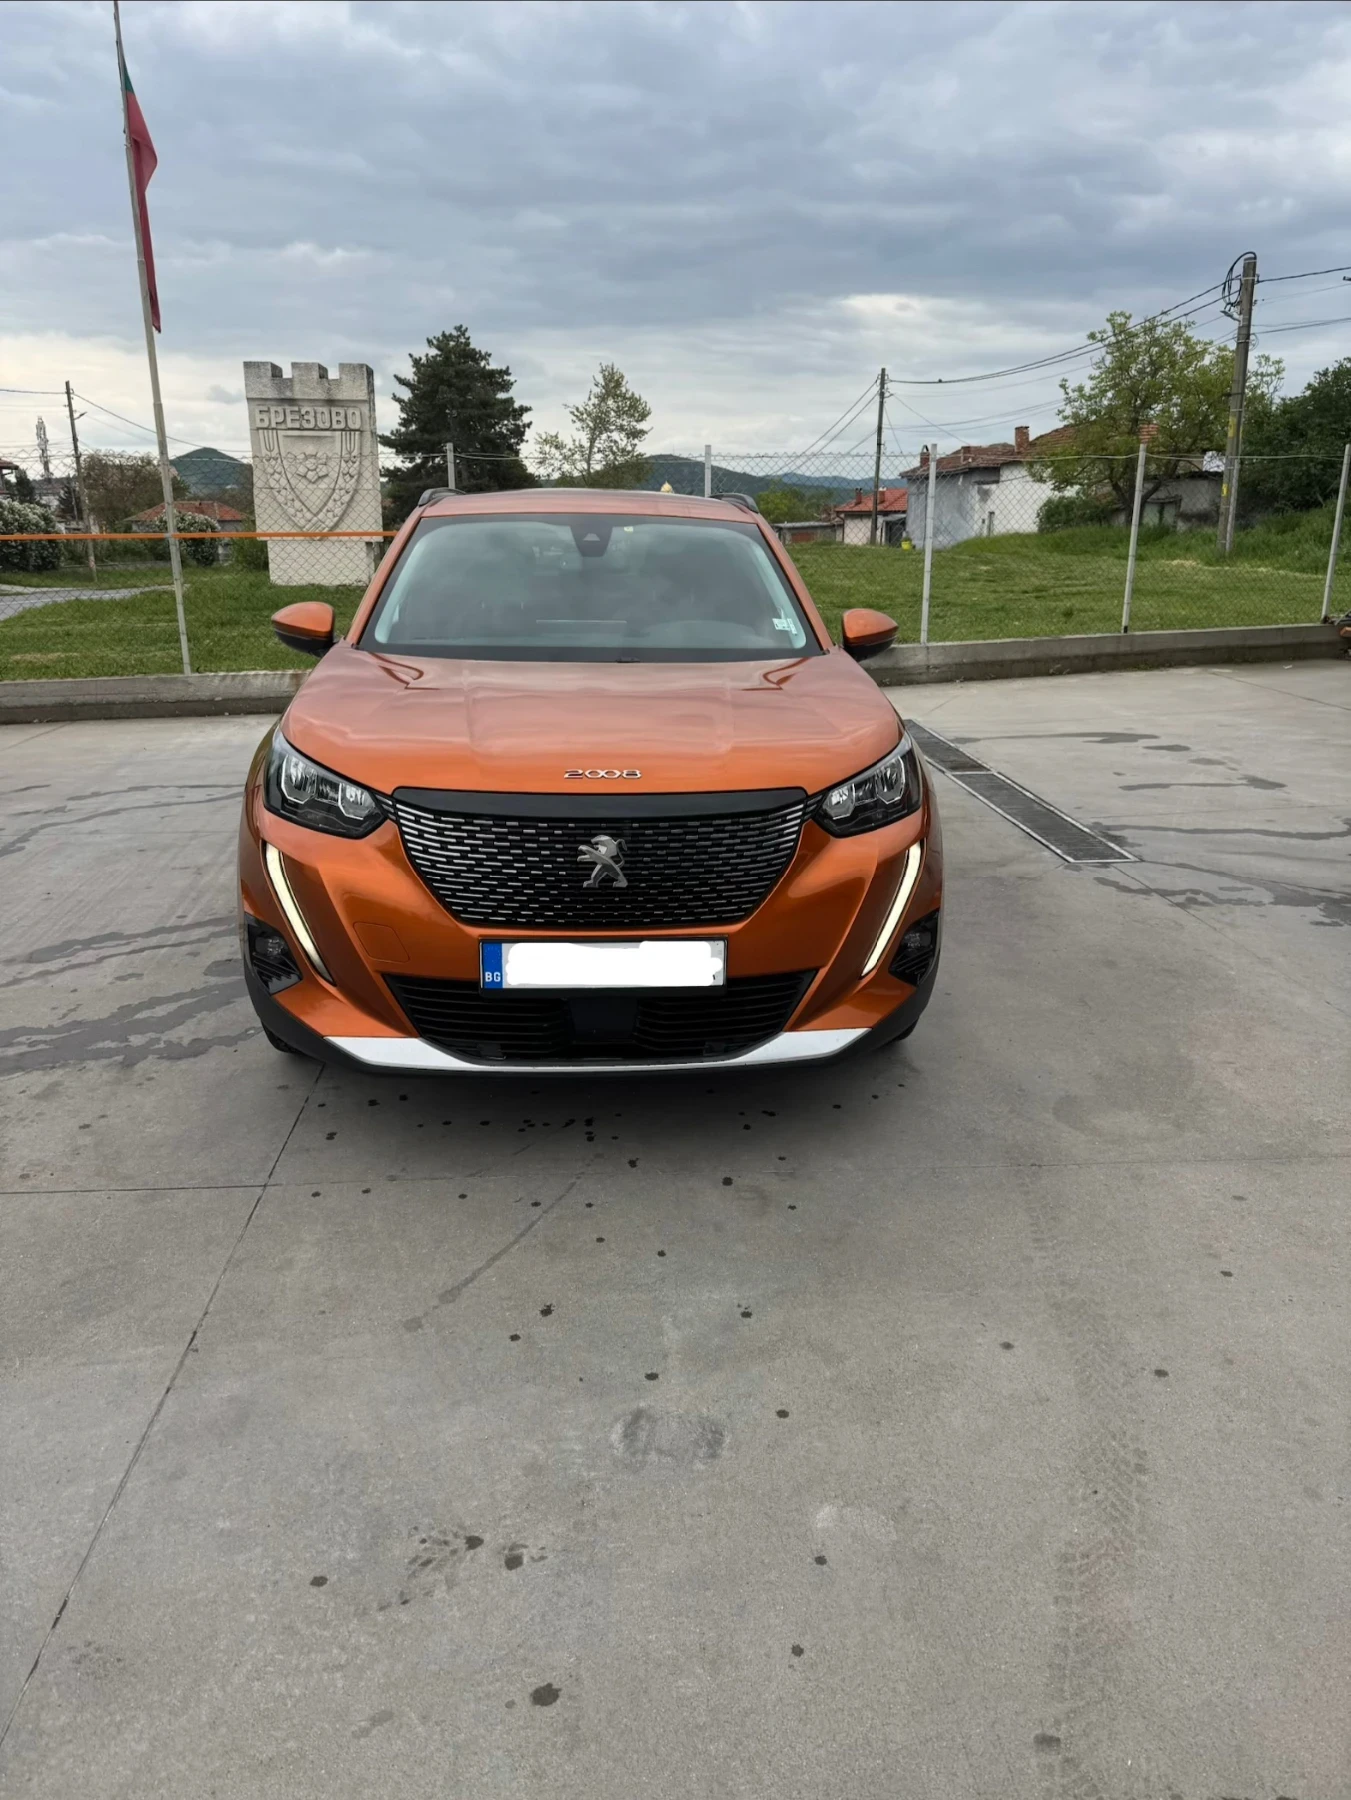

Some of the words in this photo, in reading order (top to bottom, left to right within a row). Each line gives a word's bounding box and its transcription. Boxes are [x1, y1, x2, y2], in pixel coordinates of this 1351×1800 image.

[255, 406, 362, 430] БРЕЗОВО
[564, 769, 641, 779] 2008
[485, 971, 501, 982] BG
